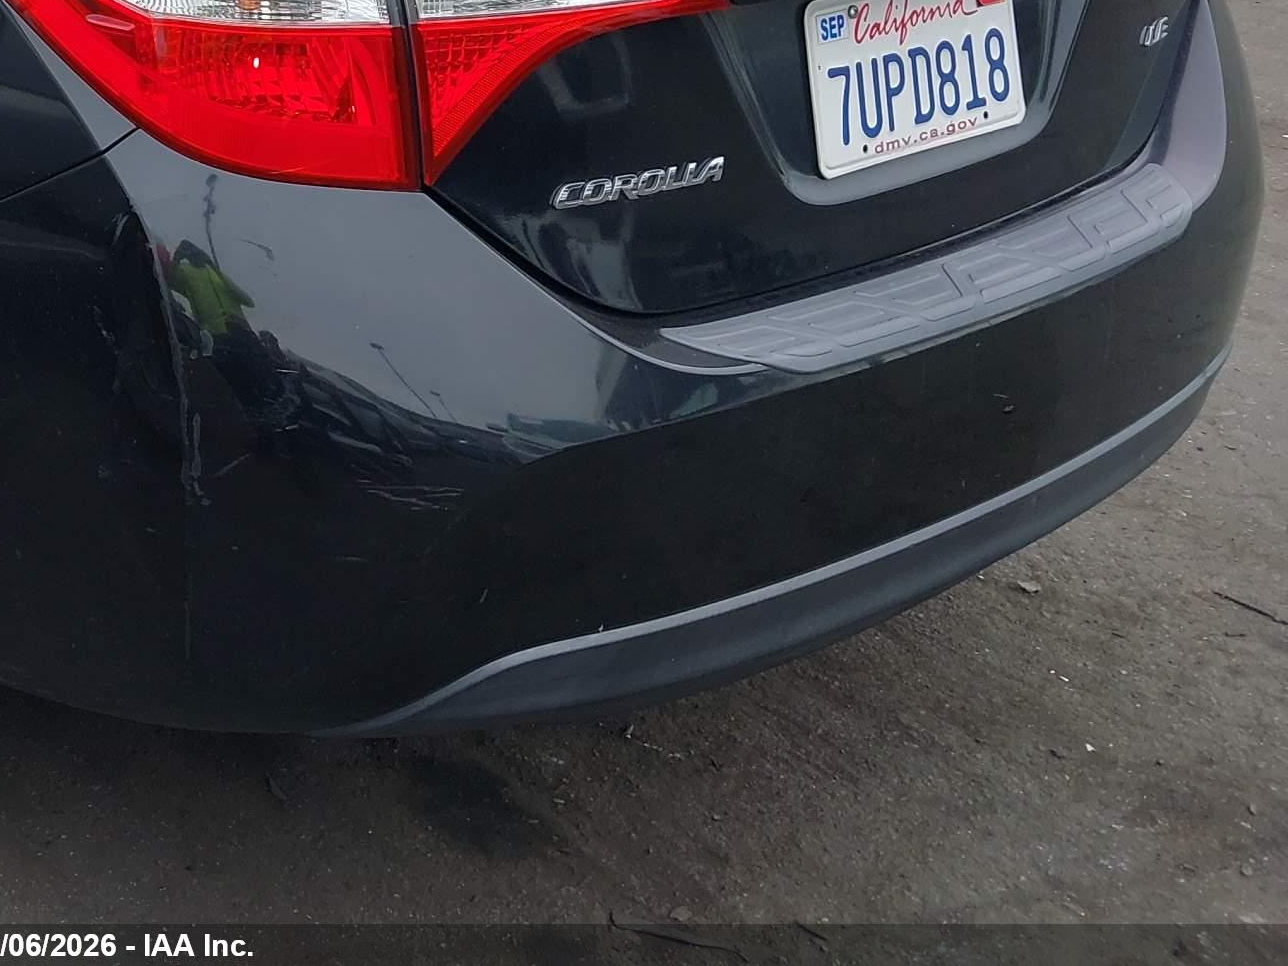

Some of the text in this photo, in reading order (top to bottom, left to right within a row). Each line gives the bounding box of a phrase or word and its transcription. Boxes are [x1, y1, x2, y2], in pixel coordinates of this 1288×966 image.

[820, 14, 845, 41] SEP
[827, 27, 1010, 146] 7UPD818
[874, 116, 978, 155] dmv.ca.gov
[550, 155, 725, 210] COROLLA
